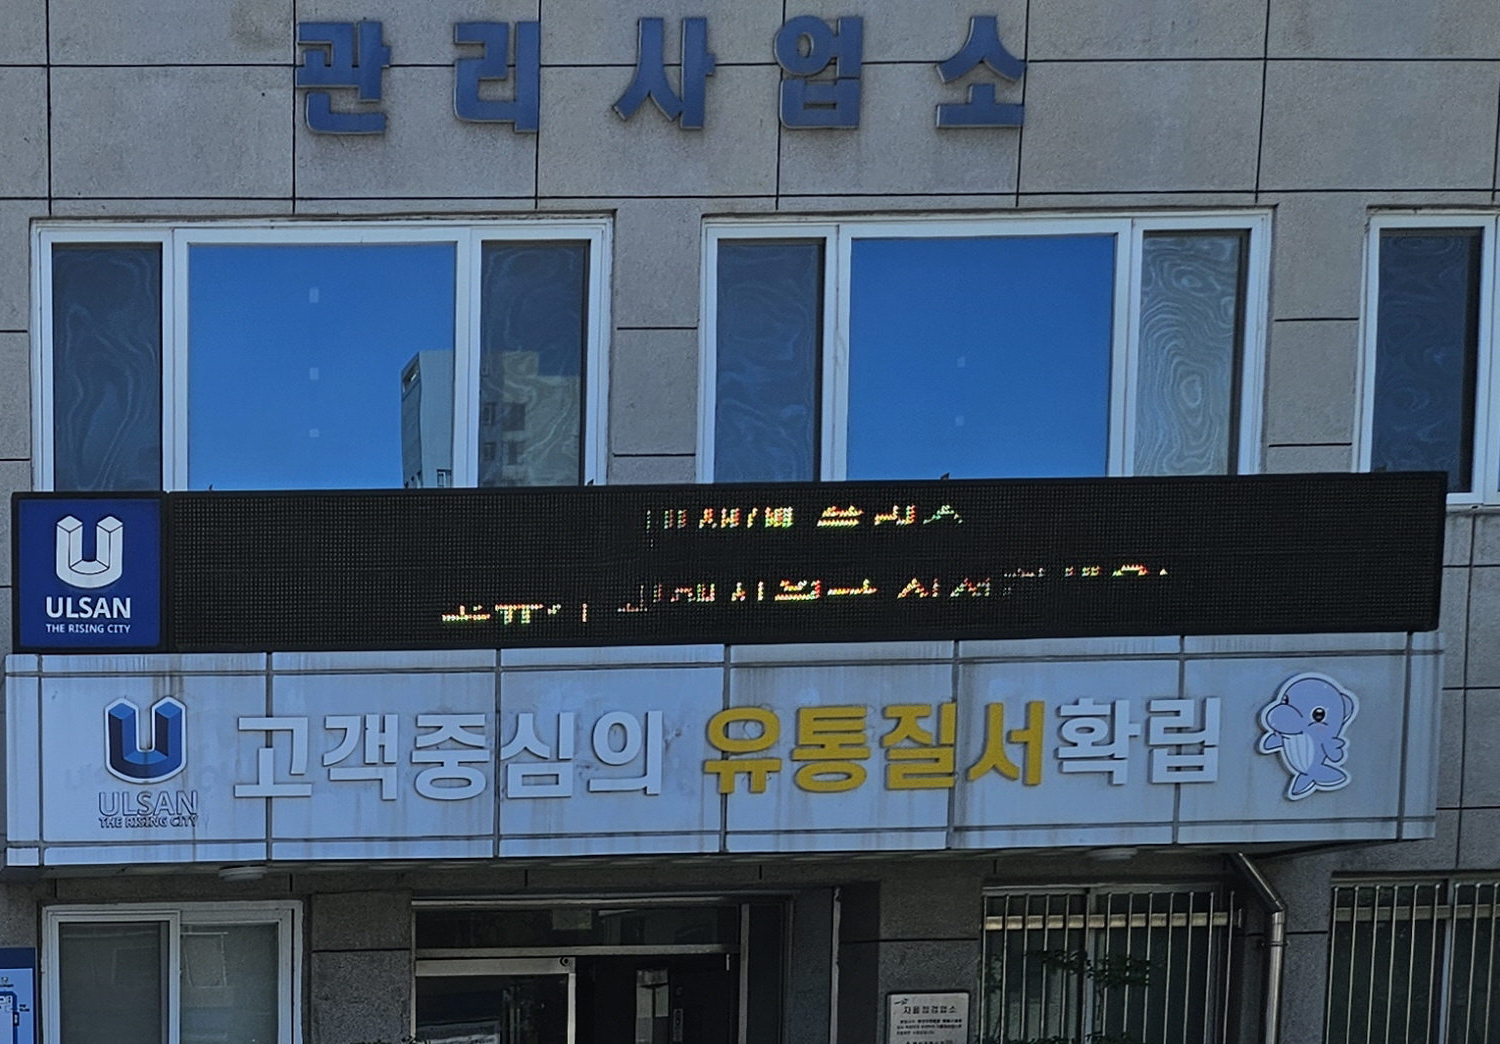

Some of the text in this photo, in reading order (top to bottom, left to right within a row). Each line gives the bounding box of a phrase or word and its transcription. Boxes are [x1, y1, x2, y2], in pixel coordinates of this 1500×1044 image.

[295, 16, 1026, 134] 관리사업소
[46, 596, 131, 618] ULSAN
[46, 623, 131, 633] THE RISING CITY
[234, 697, 1220, 801] 고객중심의 유통질서확립
[98, 790, 198, 816] ULSAN
[98, 815, 199, 828] THE RISING CITY
